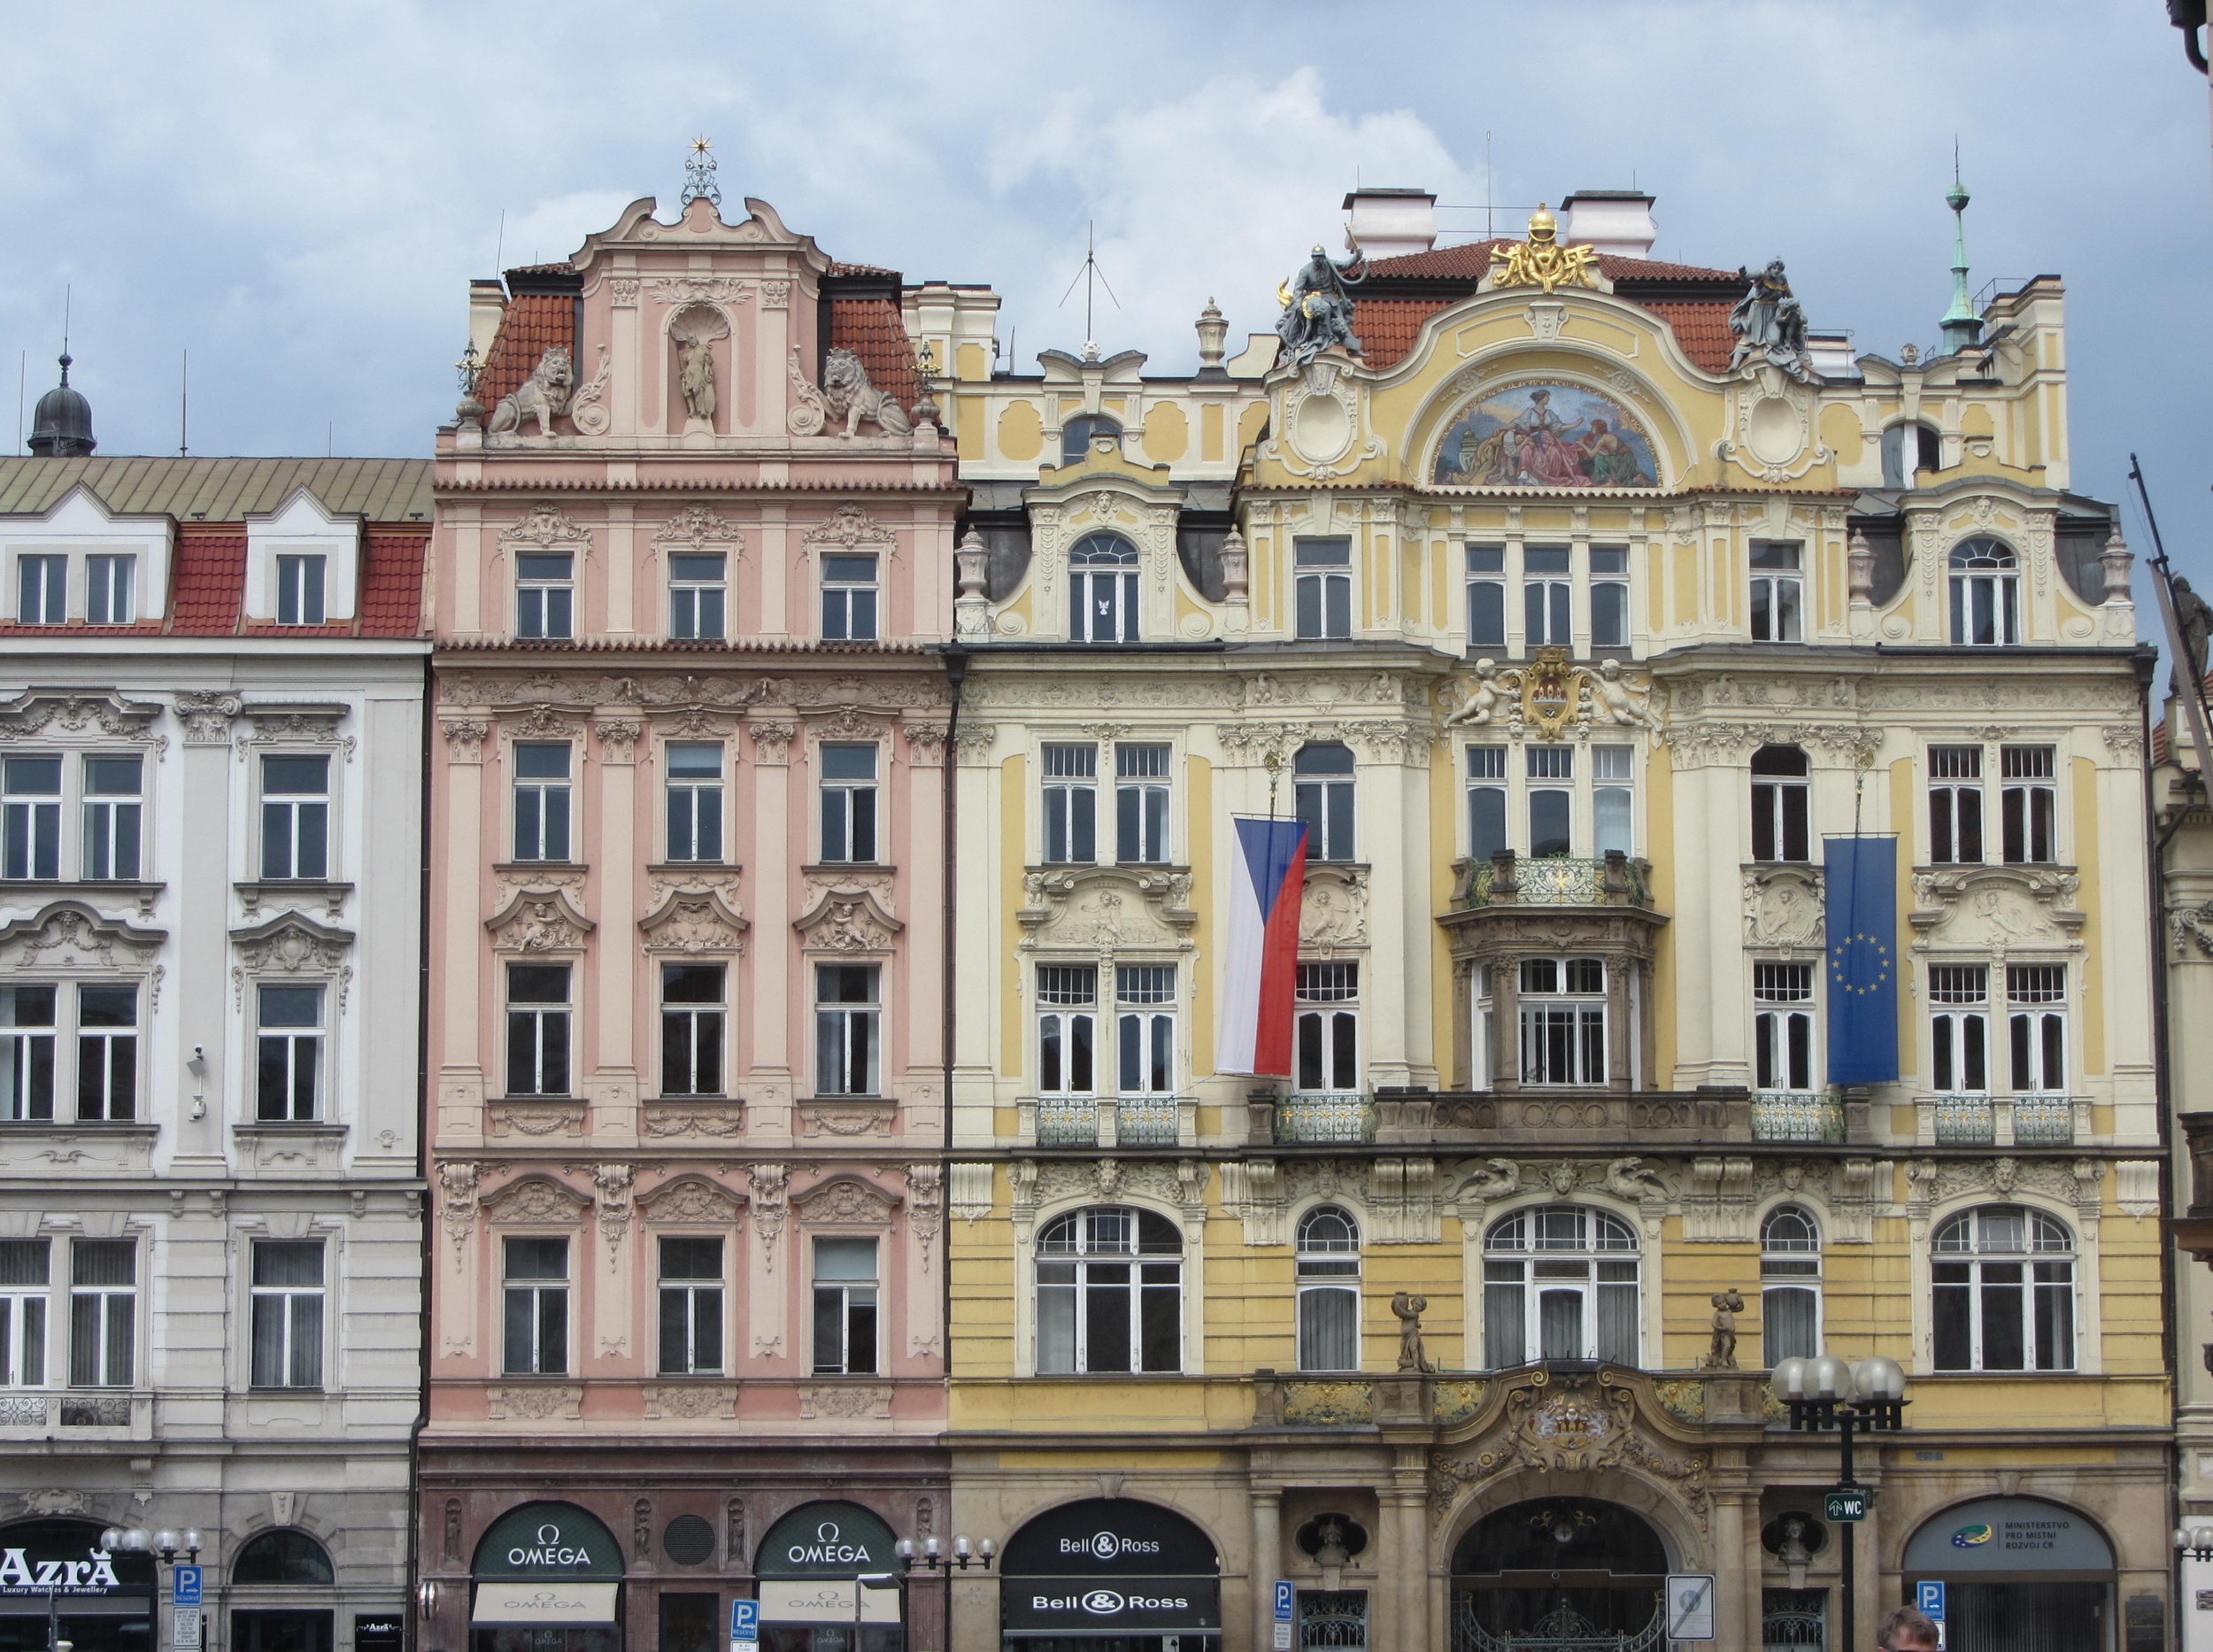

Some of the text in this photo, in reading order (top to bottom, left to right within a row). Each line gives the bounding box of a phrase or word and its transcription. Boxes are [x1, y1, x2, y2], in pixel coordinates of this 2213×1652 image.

[1844, 1501, 1862, 1515] WC
[1060, 1535, 1160, 1553] Bell & Ross
[2042, 1540, 2054, 1549] ČR
[508, 1548, 591, 1565] OMEGA
[788, 1545, 871, 1563] OMEGA
[3, 1586, 29, 1594] Luxury
[73, 1586, 108, 1594] Jewellery
[180, 1571, 197, 1593] P
[789, 1600, 871, 1609] OMEGA
[1033, 1594, 1188, 1609] Bell & Ross
[1277, 1585, 1289, 1608] P
[1923, 1586, 1939, 1609] P
[737, 1604, 753, 1627] P
